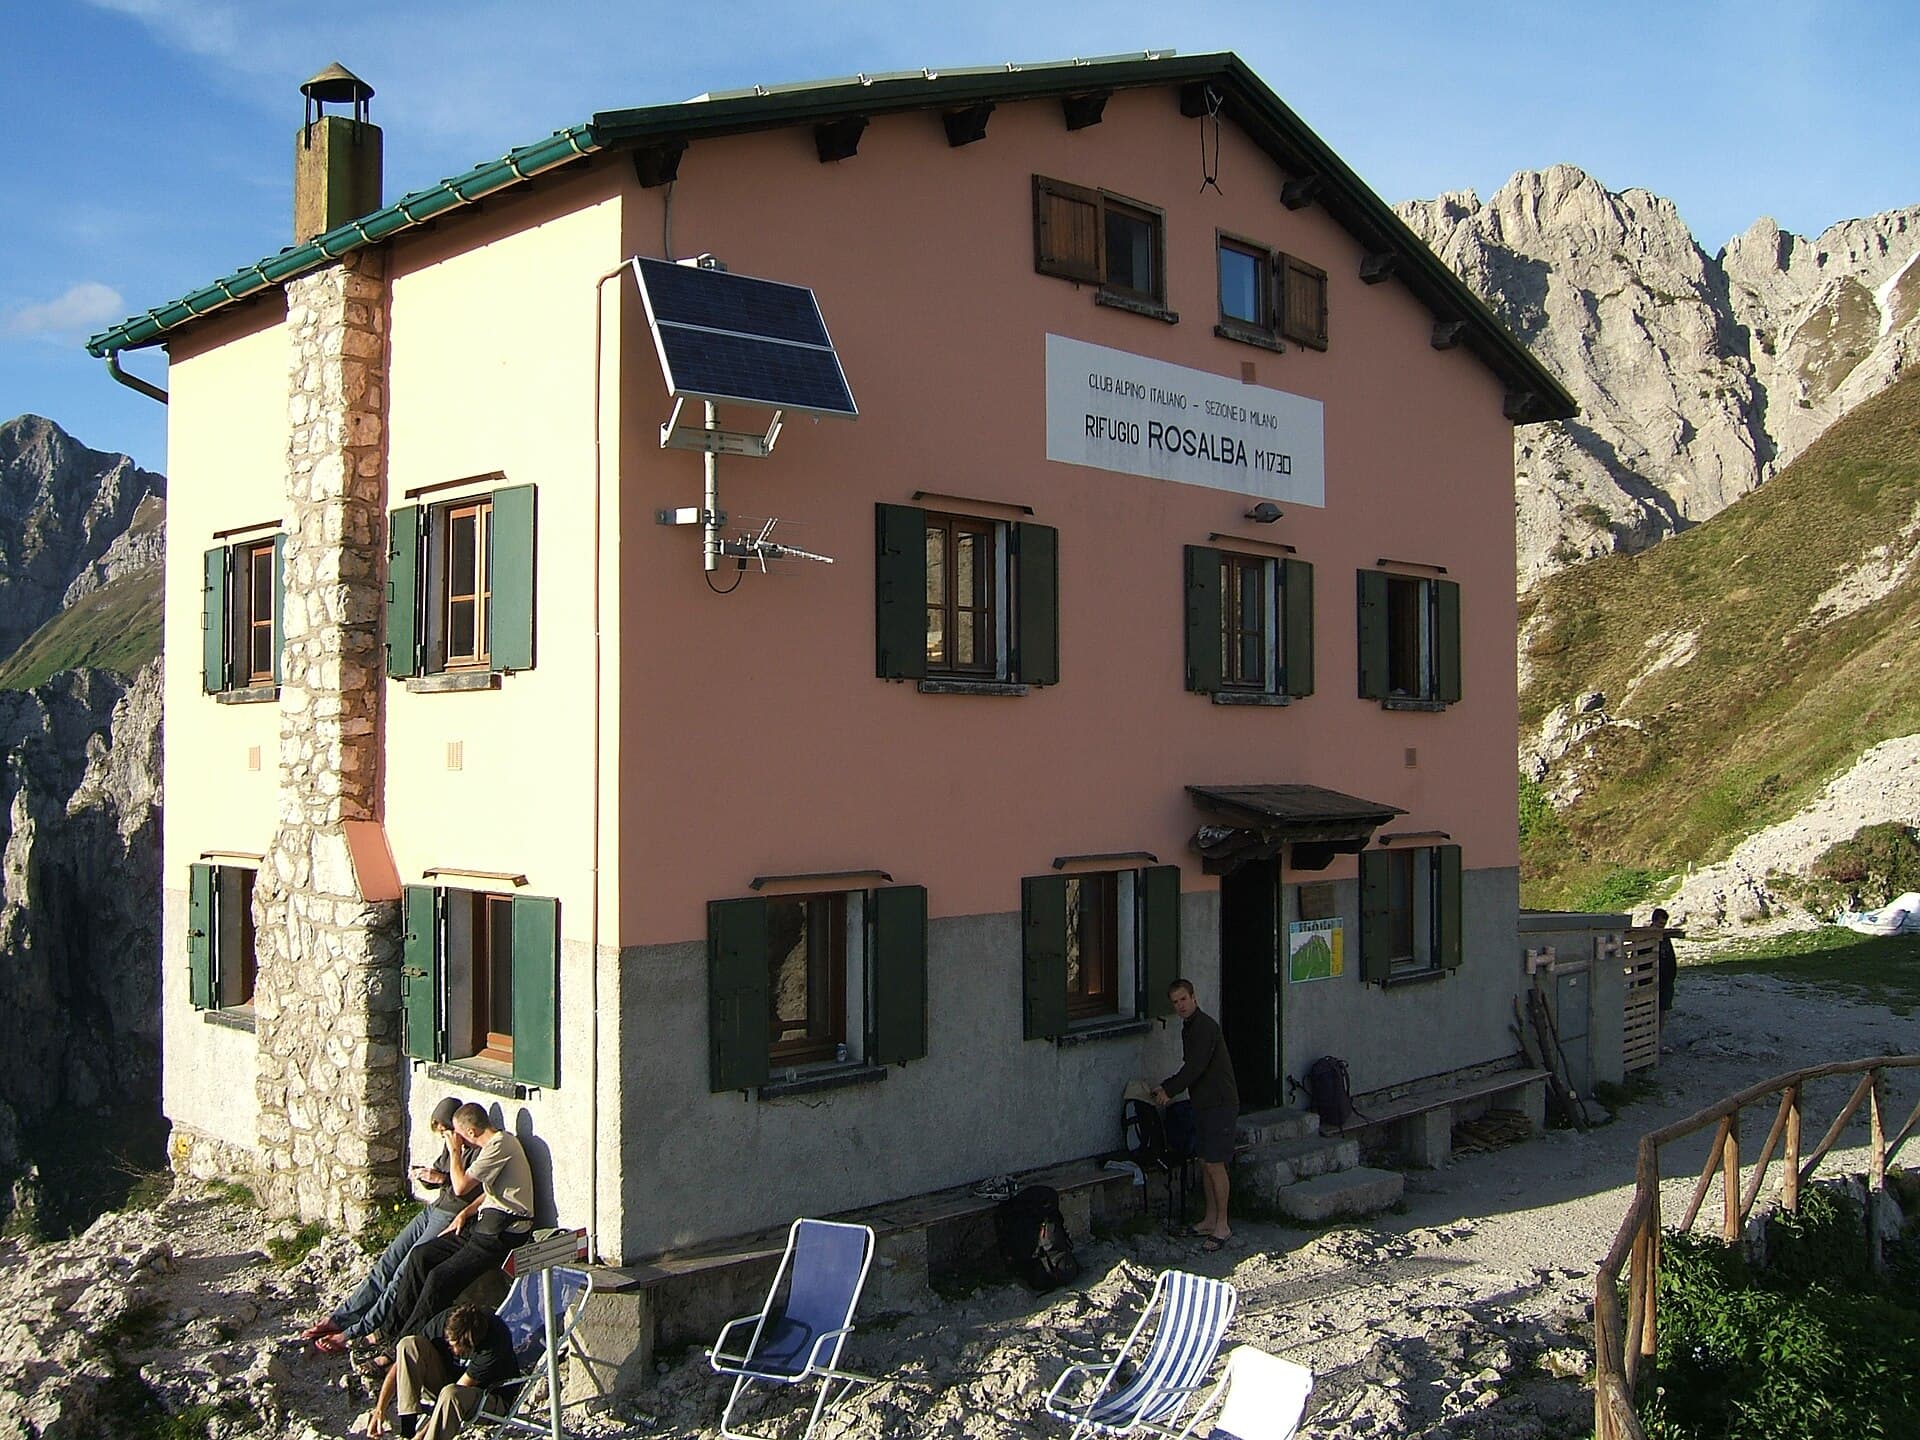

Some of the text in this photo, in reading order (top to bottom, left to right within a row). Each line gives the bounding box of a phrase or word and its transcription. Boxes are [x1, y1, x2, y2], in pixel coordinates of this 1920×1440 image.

[1089, 373, 1113, 393] CLUB
[1115, 380, 1146, 400] ALPINO
[1150, 388, 1187, 410] ITALIANO
[1205, 400, 1238, 421] SEZIONE
[1250, 410, 1278, 430] MILANO
[1085, 414, 1140, 446] RIFUGIO
[1148, 420, 1248, 468] ROSALBA
